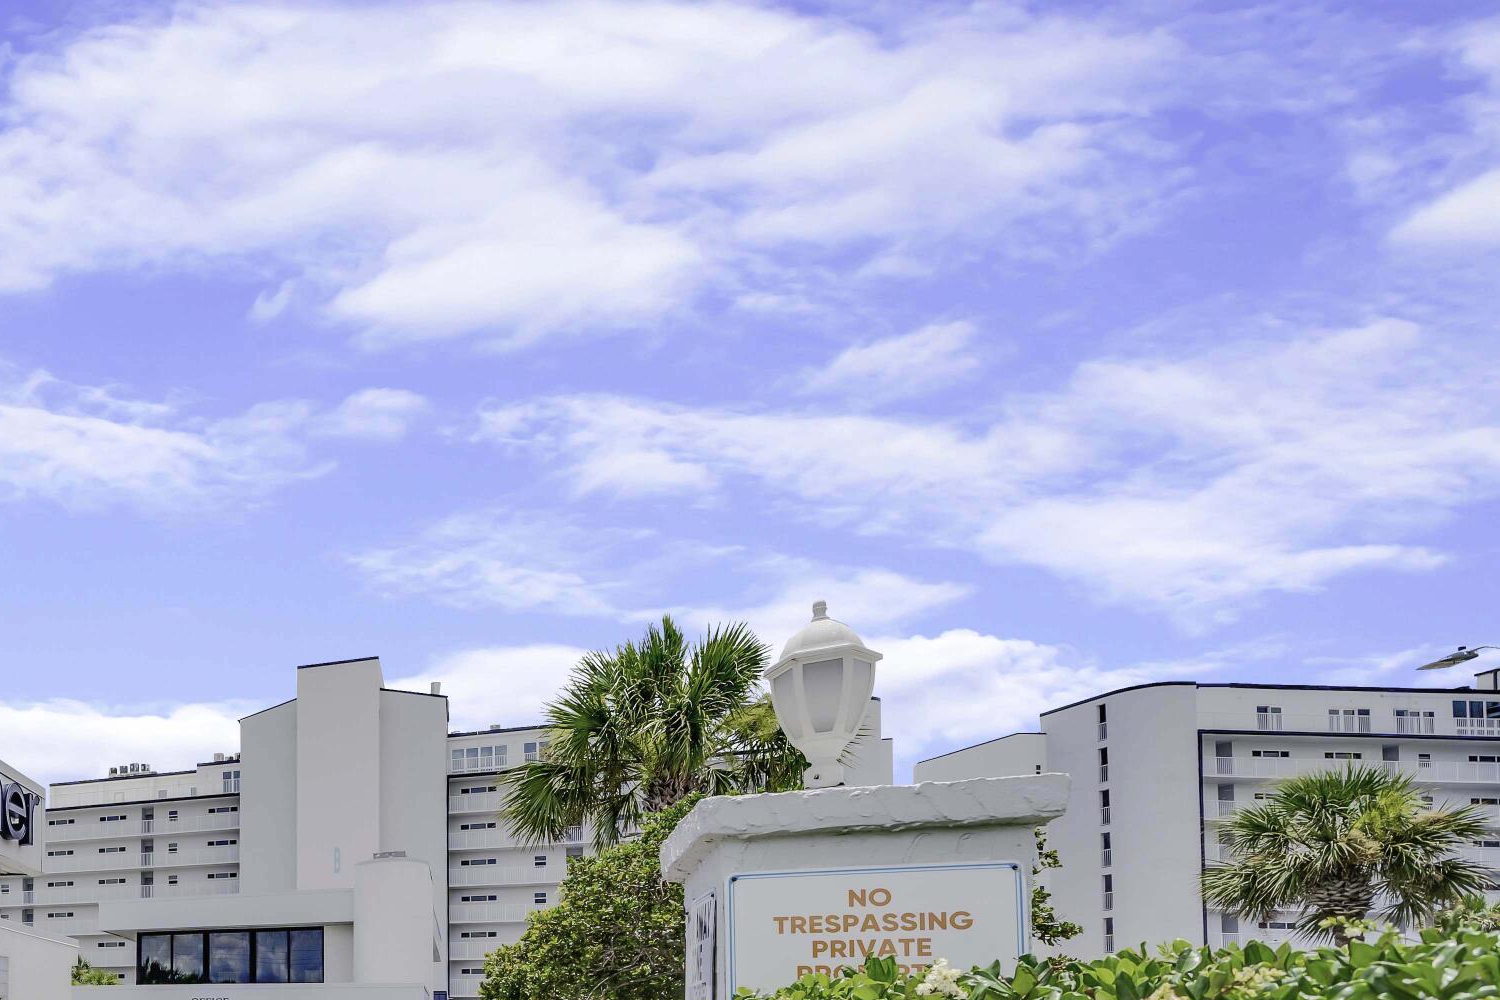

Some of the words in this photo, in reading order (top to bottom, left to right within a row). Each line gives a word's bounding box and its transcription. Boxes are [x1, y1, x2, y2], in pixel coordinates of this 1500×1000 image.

[848, 888, 892, 907] NO
[772, 911, 974, 934] TRESPASSING
[812, 938, 933, 958] PRIVATE
